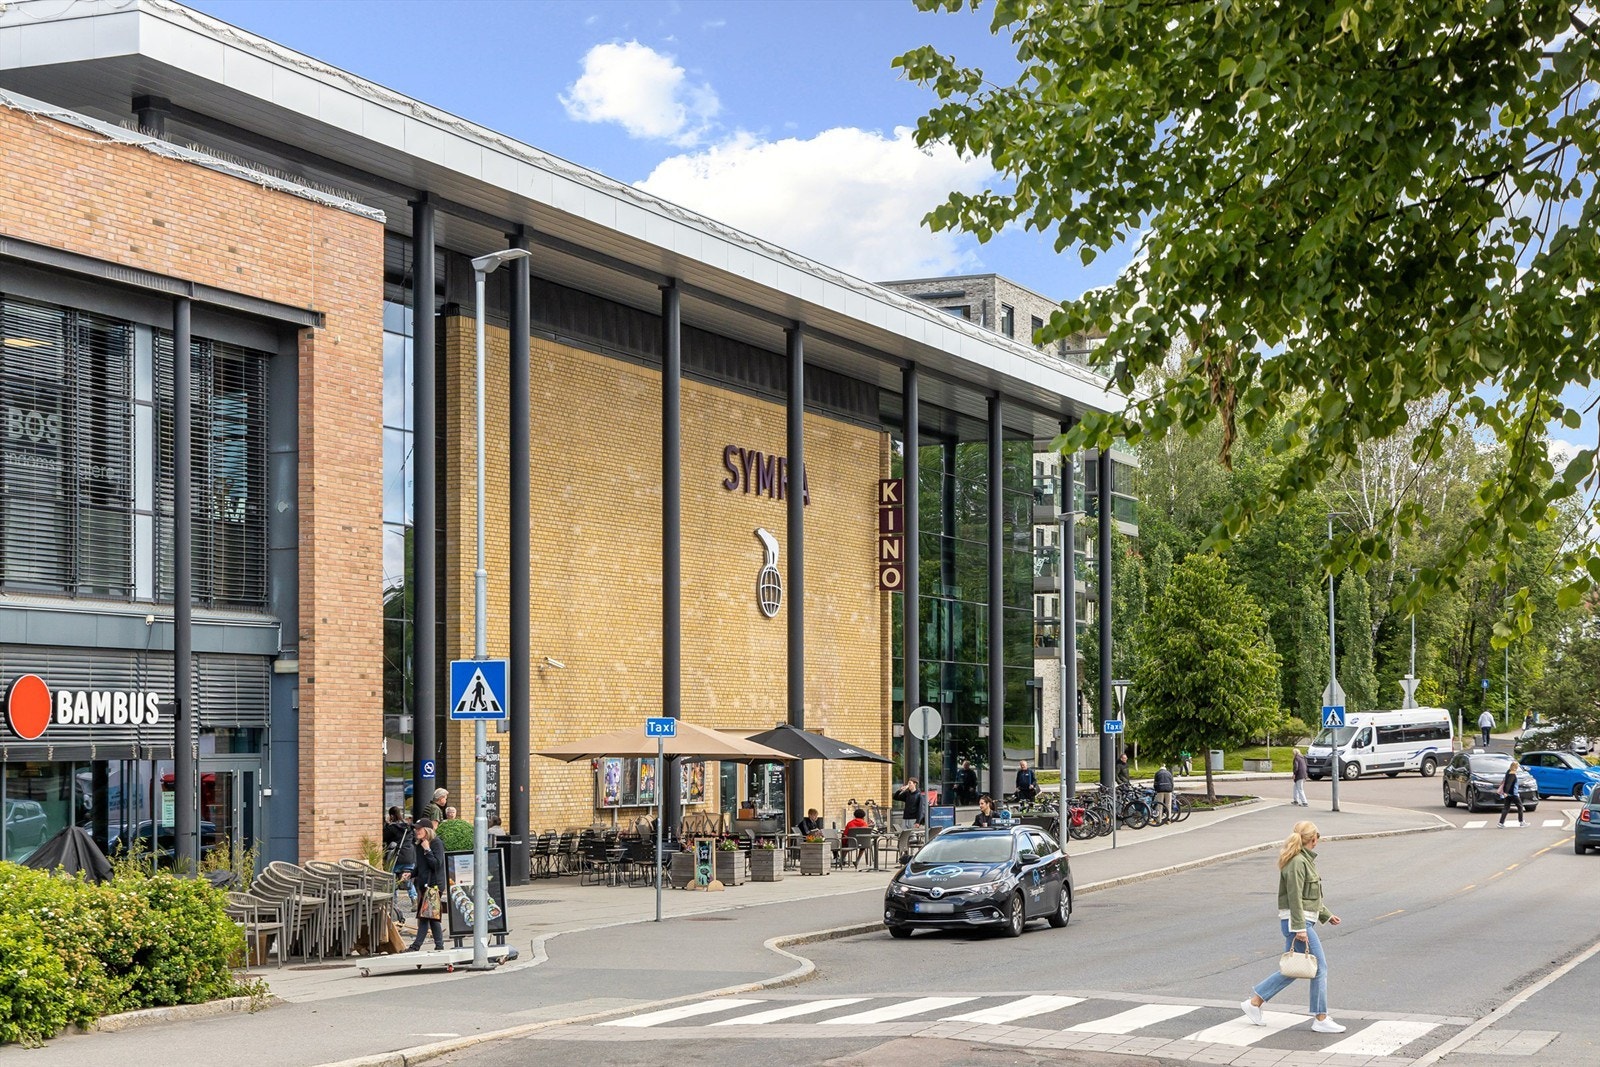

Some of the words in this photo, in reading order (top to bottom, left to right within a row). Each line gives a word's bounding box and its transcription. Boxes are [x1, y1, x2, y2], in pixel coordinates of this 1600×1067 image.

[882, 482, 900, 588] KINO
[57, 690, 160, 725] BAMBUS
[648, 721, 674, 733] Taxi
[1106, 723, 1122, 731] Taxi
